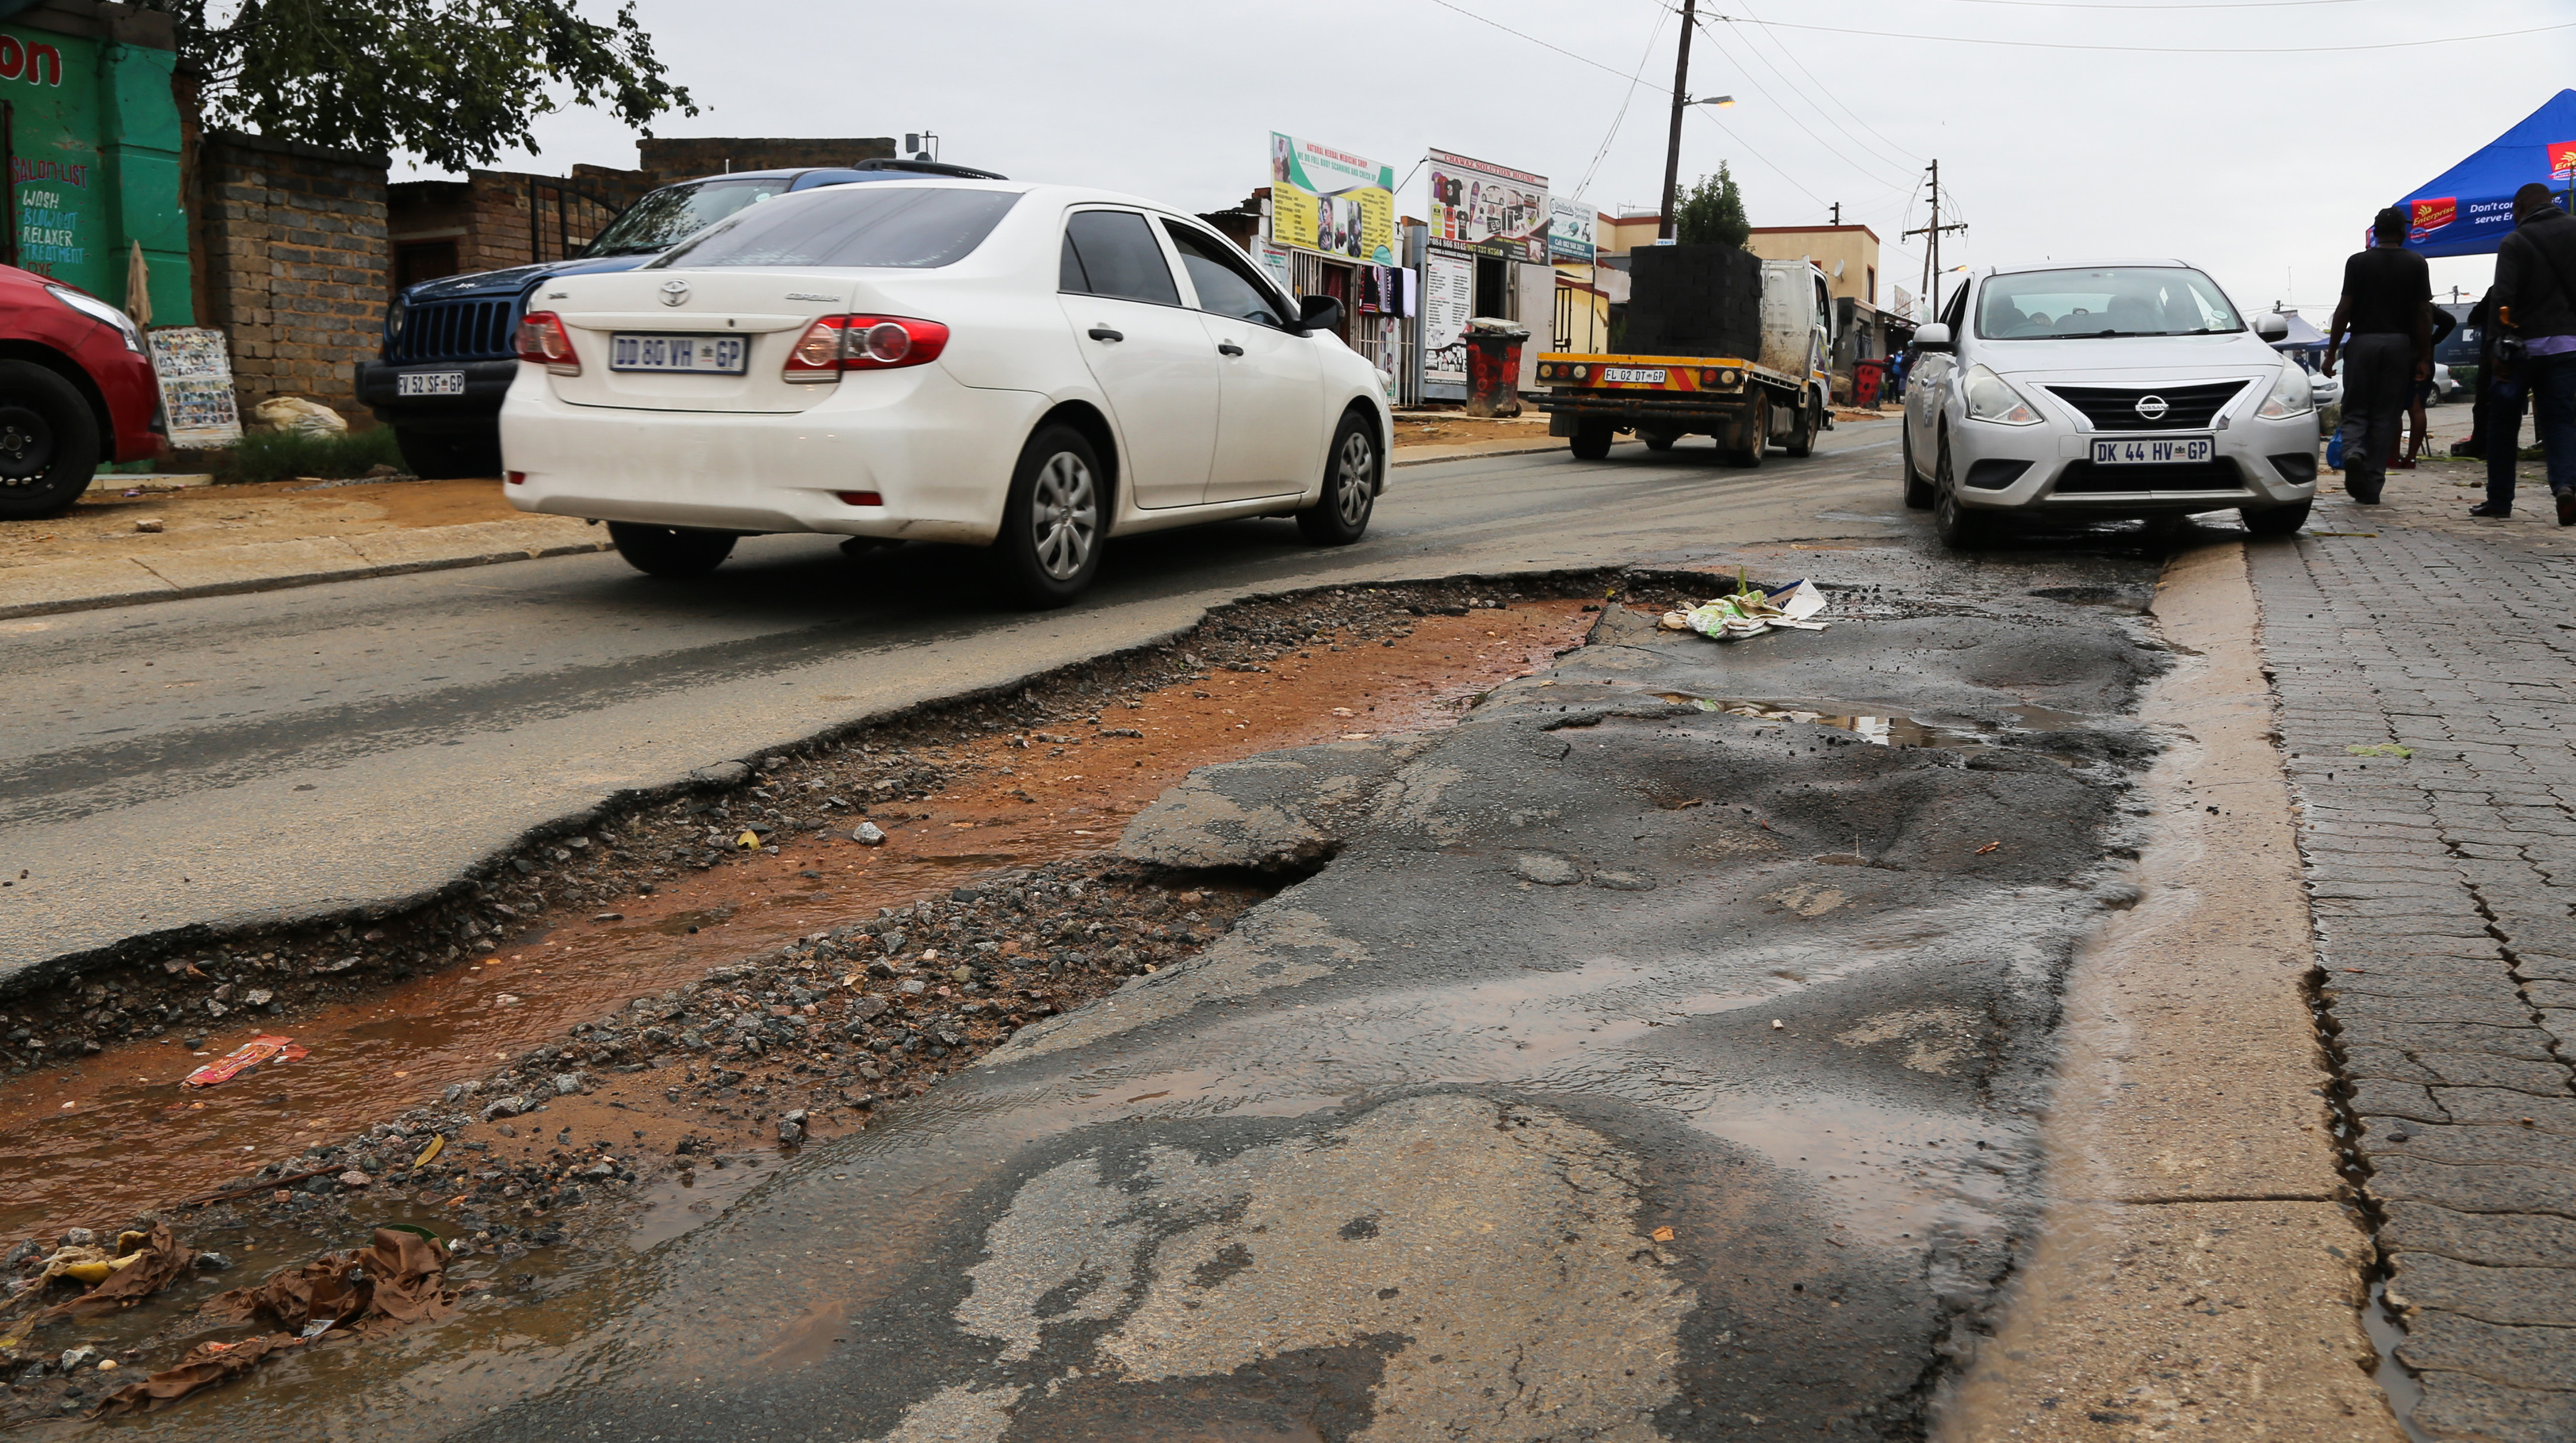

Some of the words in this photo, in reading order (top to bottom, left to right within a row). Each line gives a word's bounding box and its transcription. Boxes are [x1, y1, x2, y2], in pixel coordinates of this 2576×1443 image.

[1306, 143, 1324, 156] NATURAL
[1324, 148, 1339, 160] HERBAL
[1339, 153, 1357, 165] MEDICINE
[1298, 151, 1303, 161] WE
[1304, 153, 1311, 163] DO
[1311, 154, 1320, 165] FULL
[1321, 157, 1331, 168] BODY
[1331, 161, 1351, 175] SCANNING
[1359, 169, 1371, 180] CHECK
[1444, 154, 1474, 168] CHAWAZ
[1476, 162, 1511, 178] SOLUTION
[1512, 169, 1536, 183] HOUSE
[61, 163, 88, 189] LIST
[23, 189, 59, 208] WASH
[2470, 201, 2497, 213] Don't
[1574, 211, 1590, 222] Services
[2413, 204, 2455, 226] Enterprise
[2475, 214, 2502, 224] serve
[23, 226, 74, 247] RELAXER
[1443, 240, 1453, 249] 866
[1477, 246, 1486, 254] 737
[27, 261, 53, 277] DYE
[669, 340, 694, 366] VH
[716, 341, 740, 368] GP
[398, 376, 409, 394] FV
[412, 375, 423, 393] 52
[428, 375, 440, 393] SF
[450, 374, 463, 392] GP
[1606, 369, 1616, 380] FL
[1621, 371, 1631, 381] 02
[1635, 371, 1645, 381] DT
[1653, 371, 1663, 381] GP
[2097, 443, 2118, 462] DK
[2125, 442, 2145, 461] 44
[2152, 442, 2173, 461] HV
[2188, 441, 2208, 460] GP
